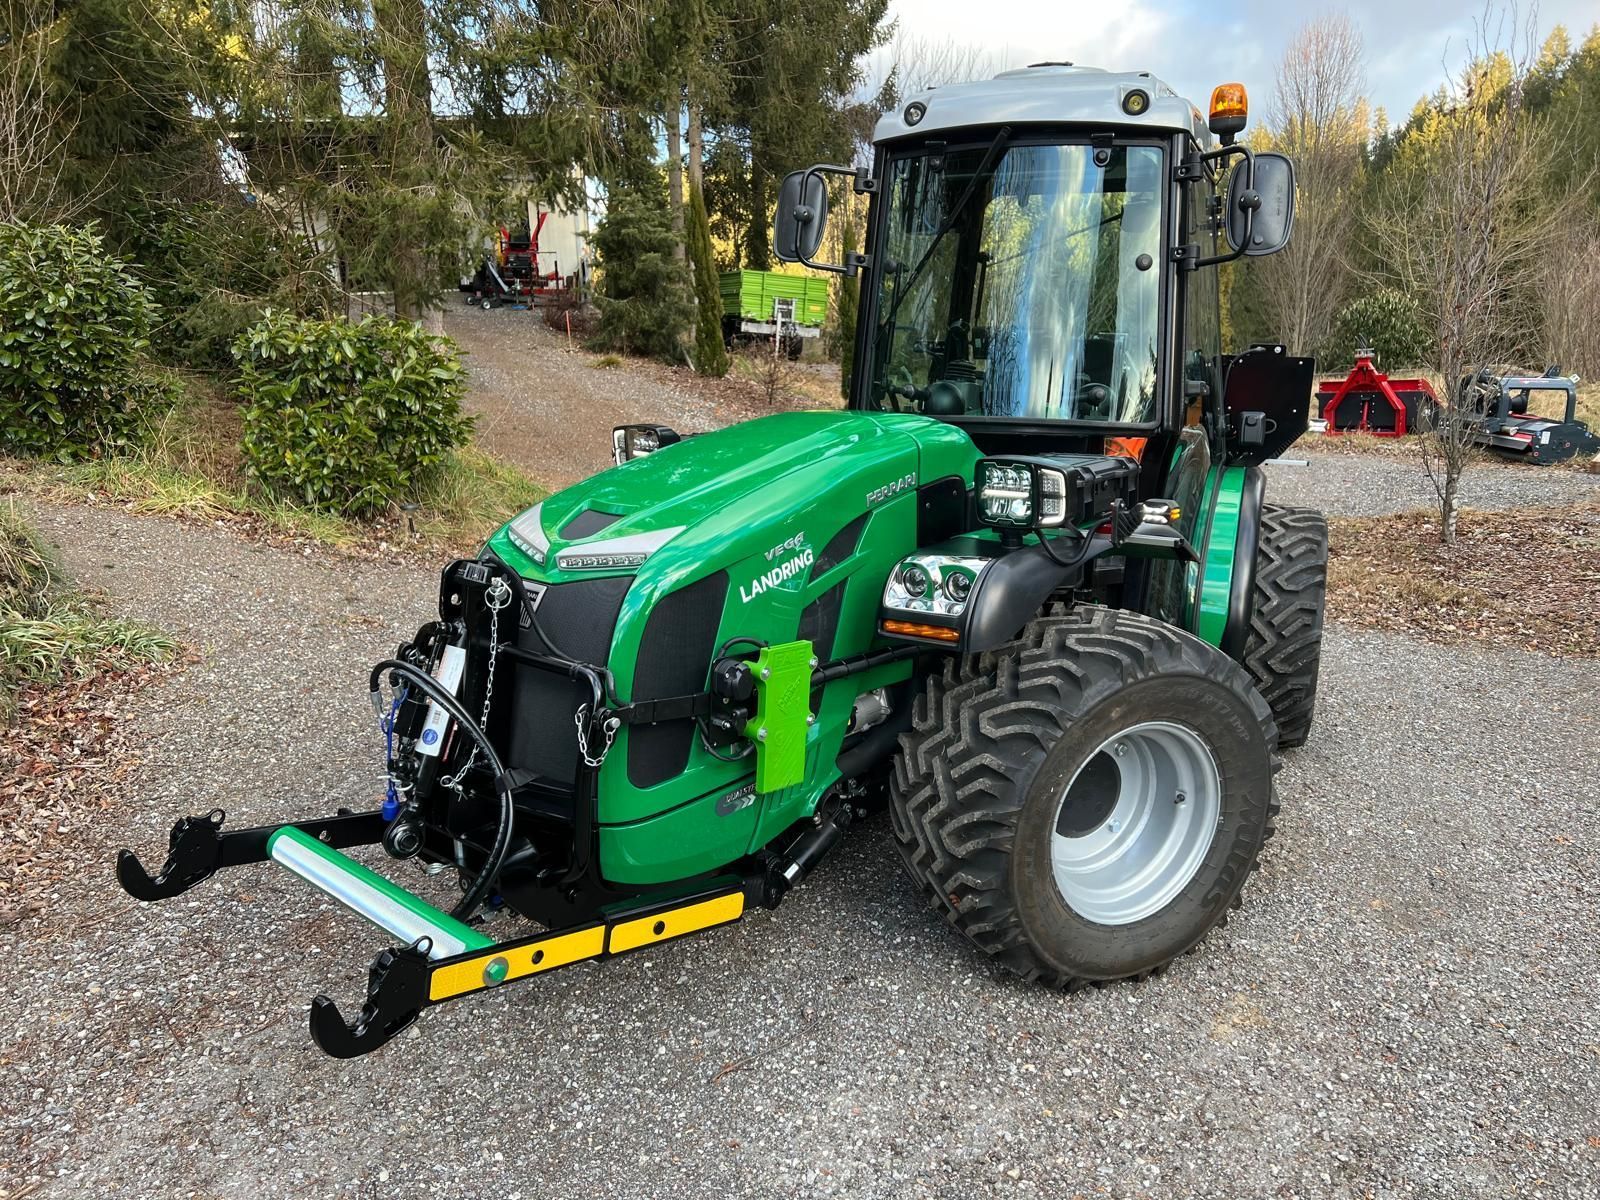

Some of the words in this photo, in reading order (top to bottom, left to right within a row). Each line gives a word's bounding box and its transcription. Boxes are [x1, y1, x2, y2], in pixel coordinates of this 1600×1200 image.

[865, 471, 917, 508] FERRARI
[763, 531, 805, 561] VEGA
[739, 548, 814, 604] LANDRING
